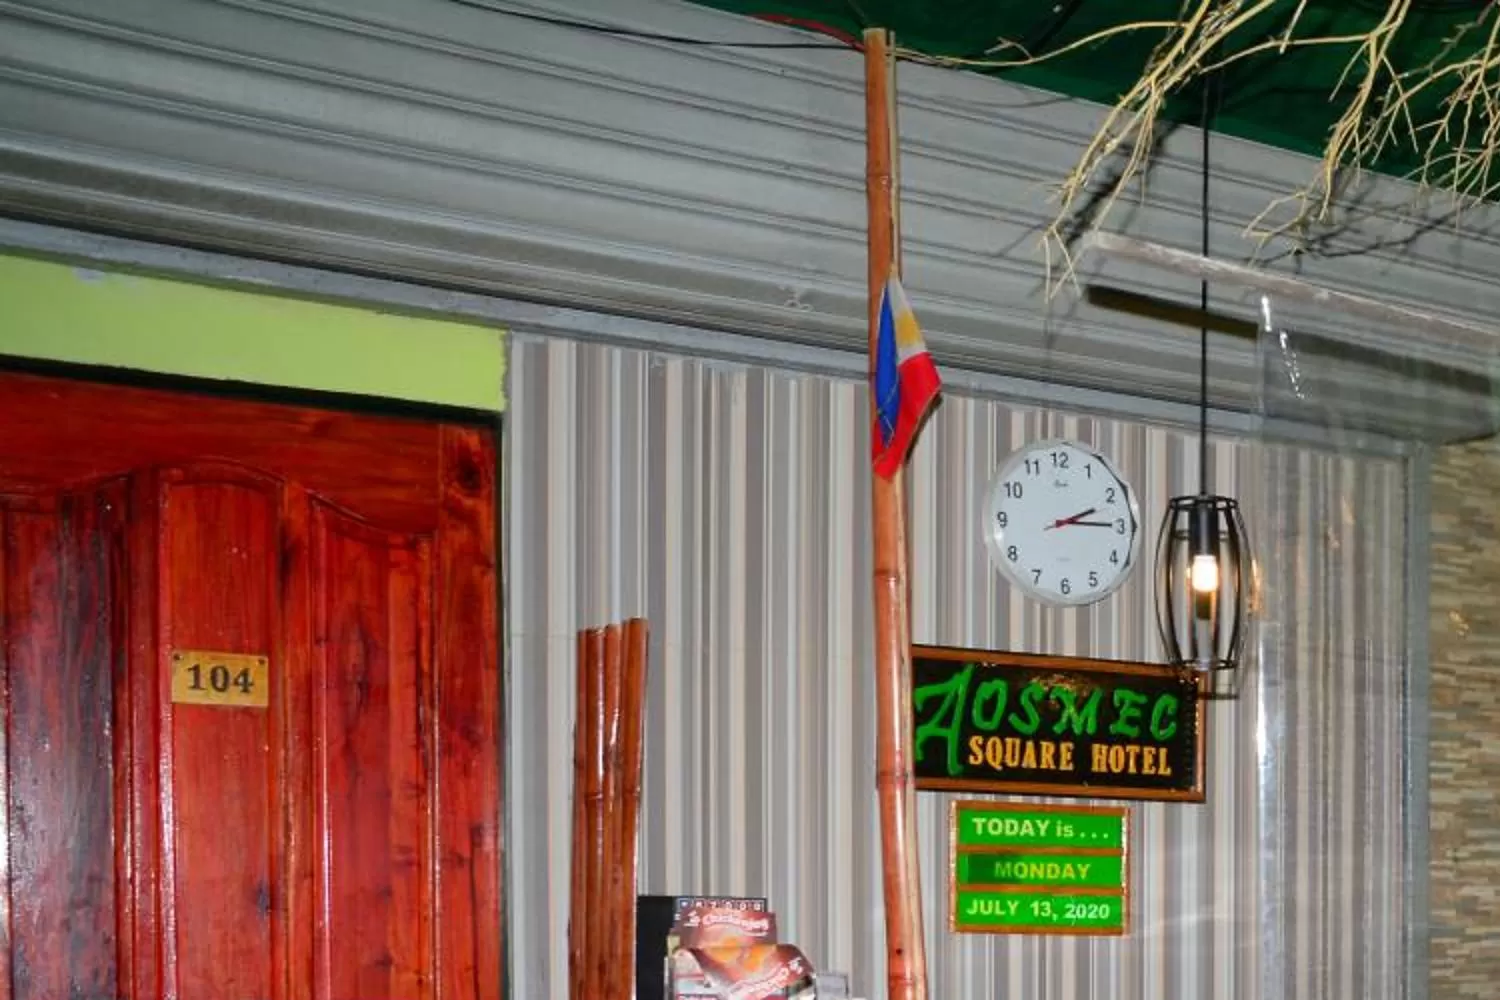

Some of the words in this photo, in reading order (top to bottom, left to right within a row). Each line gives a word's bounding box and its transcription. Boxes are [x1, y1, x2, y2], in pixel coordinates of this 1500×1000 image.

[1024, 458, 1040, 476] 11
[1051, 452, 1069, 469] 12
[1084, 463, 1092, 480] 1
[1004, 481, 1023, 499] 10
[1105, 487, 1115, 504] 2
[997, 511, 1008, 528] 9
[1116, 518, 1126, 535] 3
[1007, 545, 1018, 563] 8
[1109, 549, 1118, 565] 4
[1031, 568, 1042, 585] 7
[1088, 571, 1098, 588] 5
[1060, 578, 1071, 595] 6
[187, 663, 255, 693] 104
[914, 663, 1178, 775] AOSMEC
[968, 735, 1074, 770] SQUARE
[1091, 743, 1172, 775] HOTEL
[972, 817, 1050, 837] TODAY
[994, 861, 1091, 880] MONDAY
[966, 899, 1019, 917] JULY
[1030, 901, 1059, 921] 13,
[1064, 903, 1111, 920] 2020
